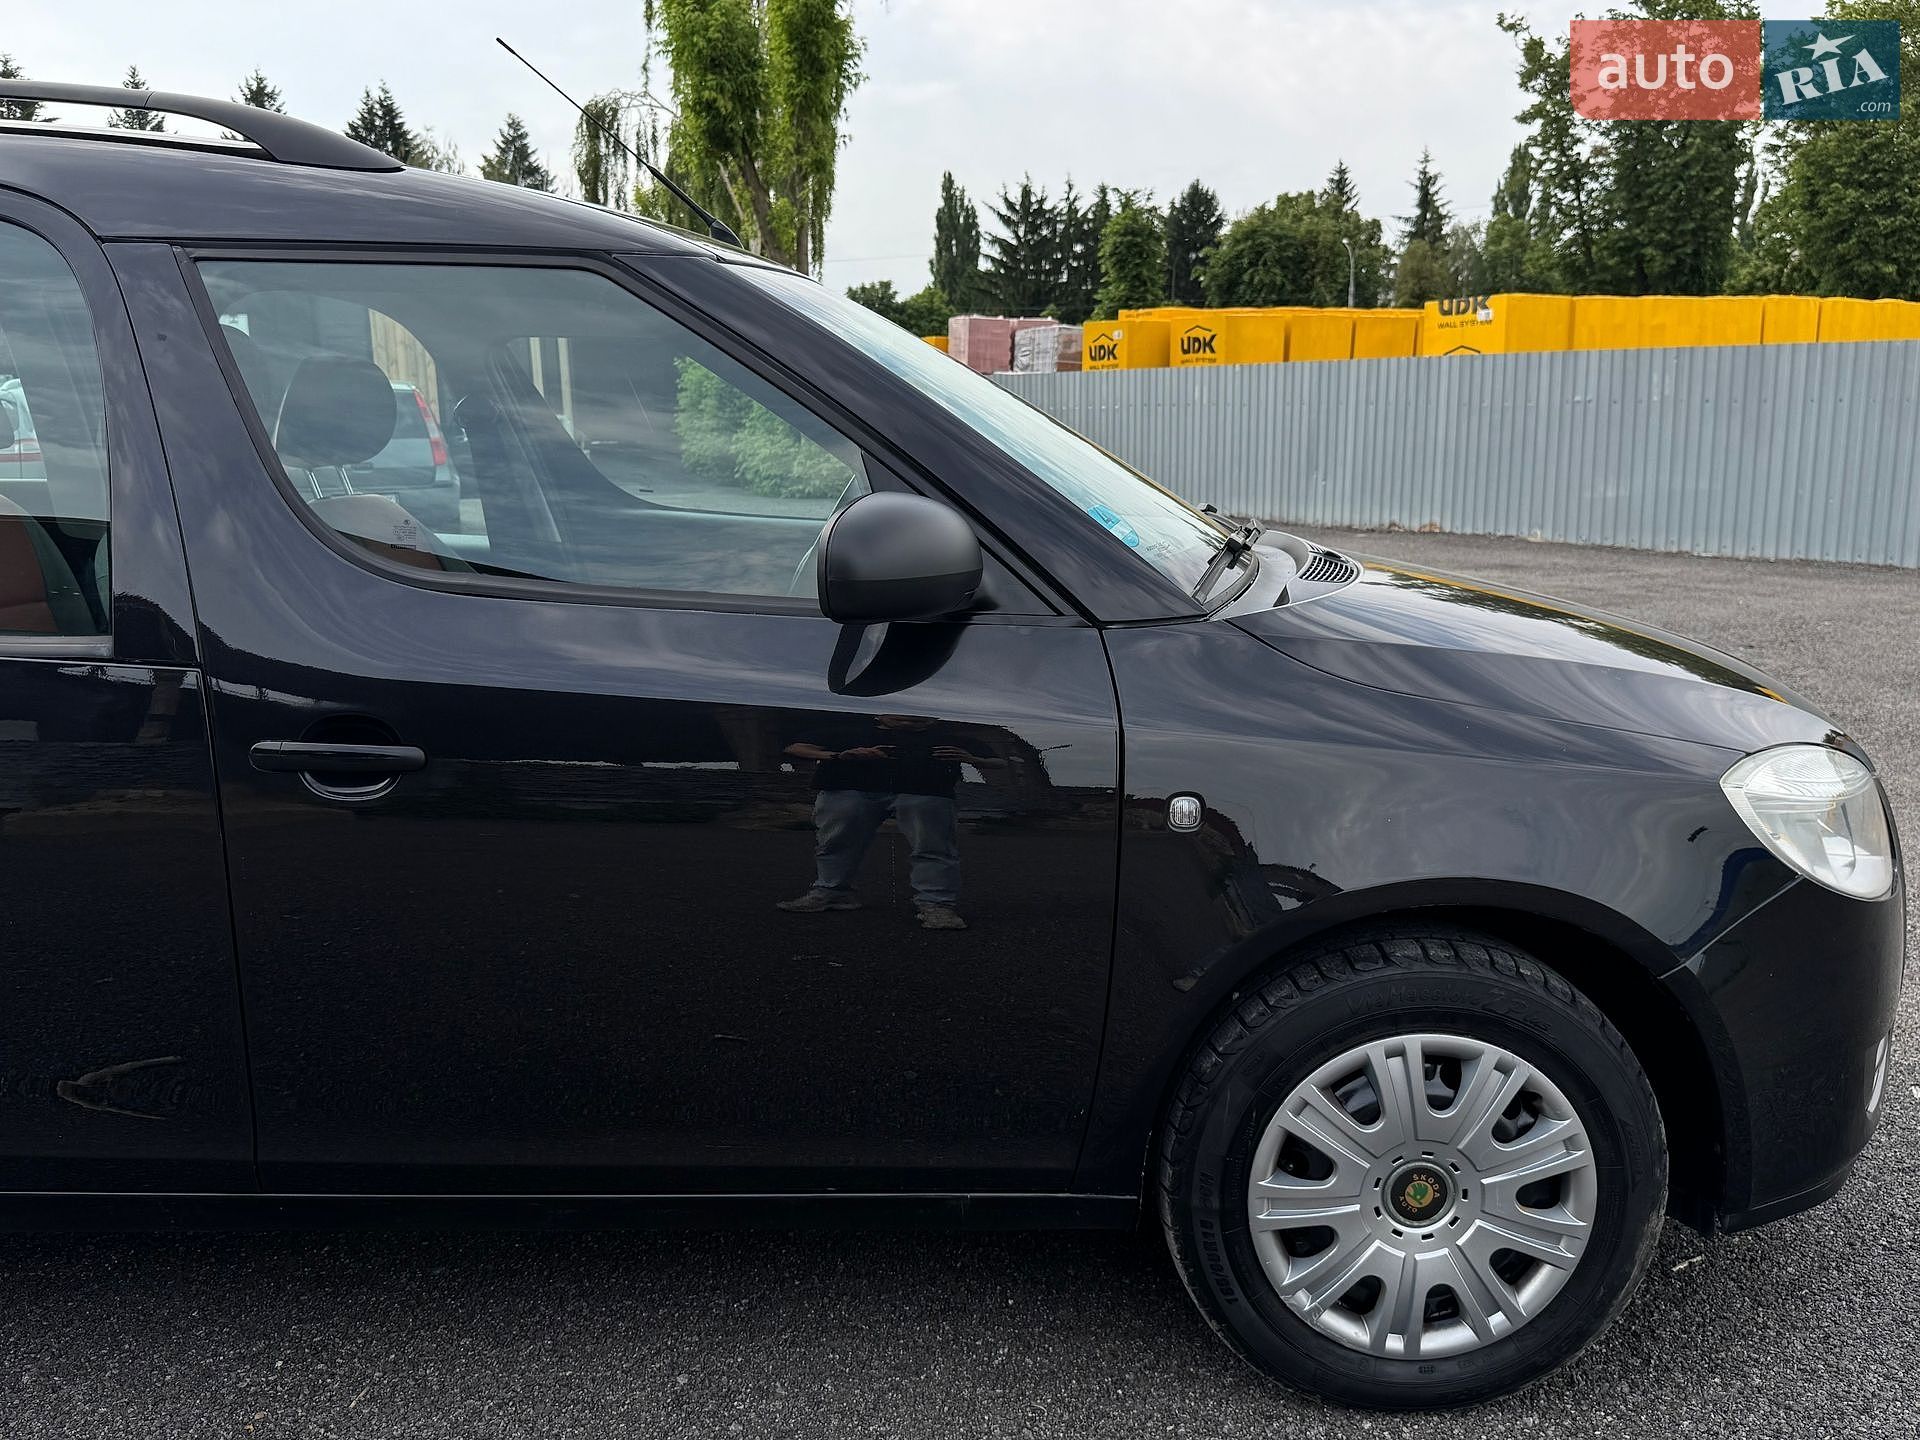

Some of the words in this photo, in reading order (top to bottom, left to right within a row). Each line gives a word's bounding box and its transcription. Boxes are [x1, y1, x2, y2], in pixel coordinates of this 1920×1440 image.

[1438, 295, 1491, 316] UDK
[1437, 321, 1458, 329] WALL
[1089, 343, 1119, 361] UDK
[1181, 334, 1217, 355] UDK
[1399, 1195, 1418, 1213] AUTO
